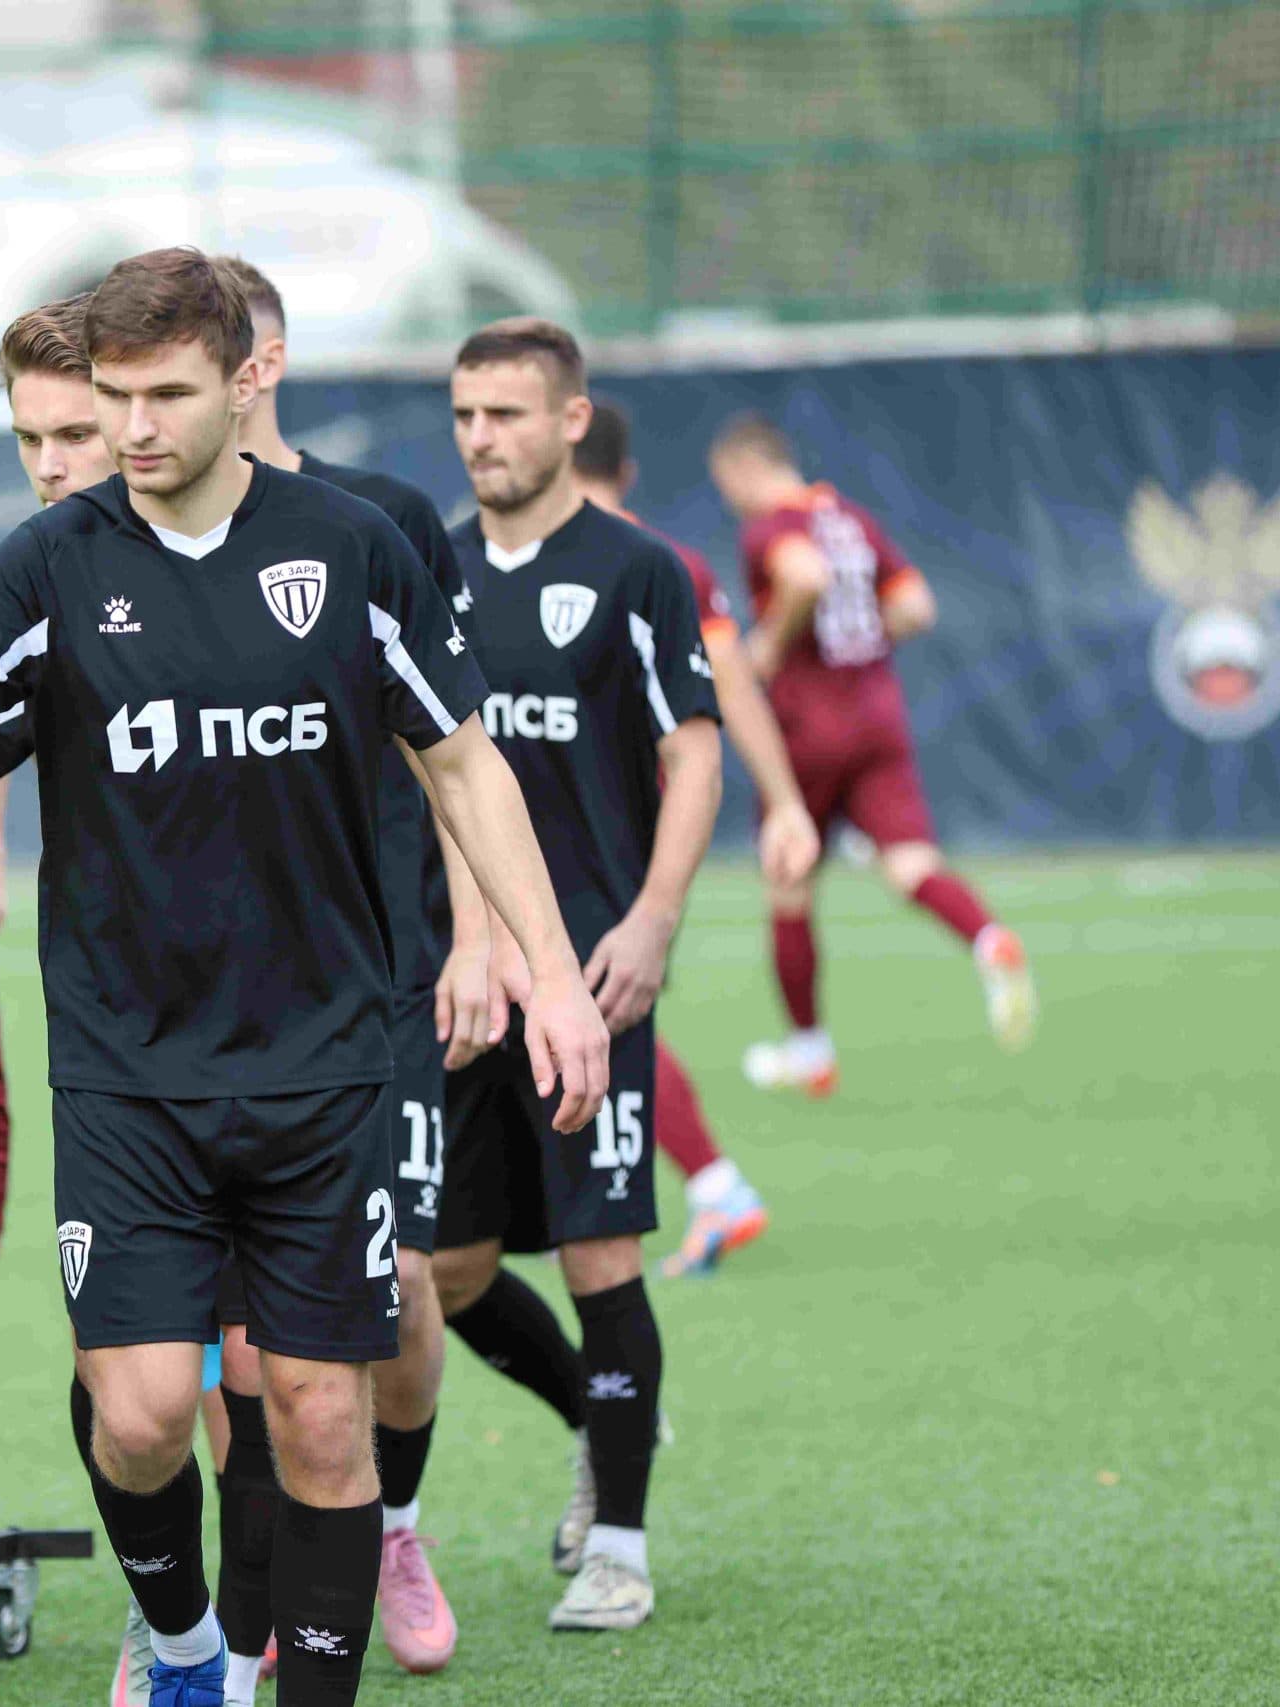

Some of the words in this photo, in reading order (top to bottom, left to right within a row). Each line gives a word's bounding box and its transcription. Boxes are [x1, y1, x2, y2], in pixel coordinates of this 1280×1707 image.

[267, 570, 284, 580] ФК
[288, 565, 318, 575] ЗАРЯ
[98, 622, 142, 633] KELME
[199, 702, 328, 757] ПСБ
[482, 692, 578, 742] ПСБ
[398, 1100, 444, 1186] 11
[590, 1090, 643, 1168] 15
[366, 1188, 398, 1278] 2
